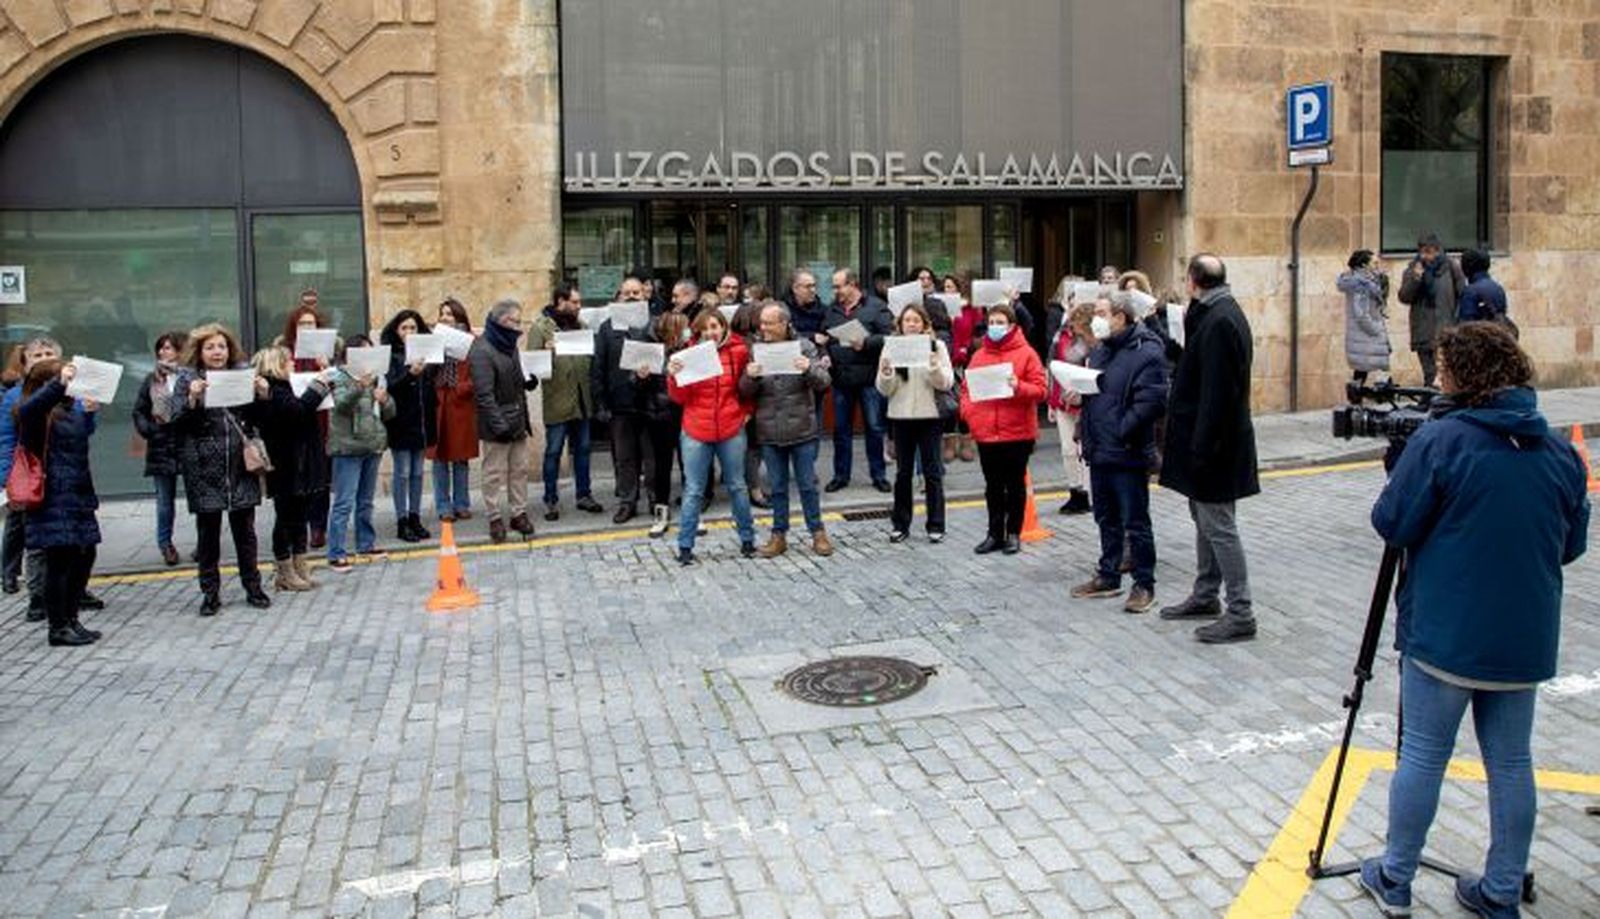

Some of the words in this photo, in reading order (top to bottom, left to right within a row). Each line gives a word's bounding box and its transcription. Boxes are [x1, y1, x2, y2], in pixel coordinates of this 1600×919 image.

[1296, 92, 1320, 141] P
[567, 151, 832, 190] JUZGADOS
[850, 151, 907, 189] DE
[922, 151, 1182, 188] SALAMANCA
